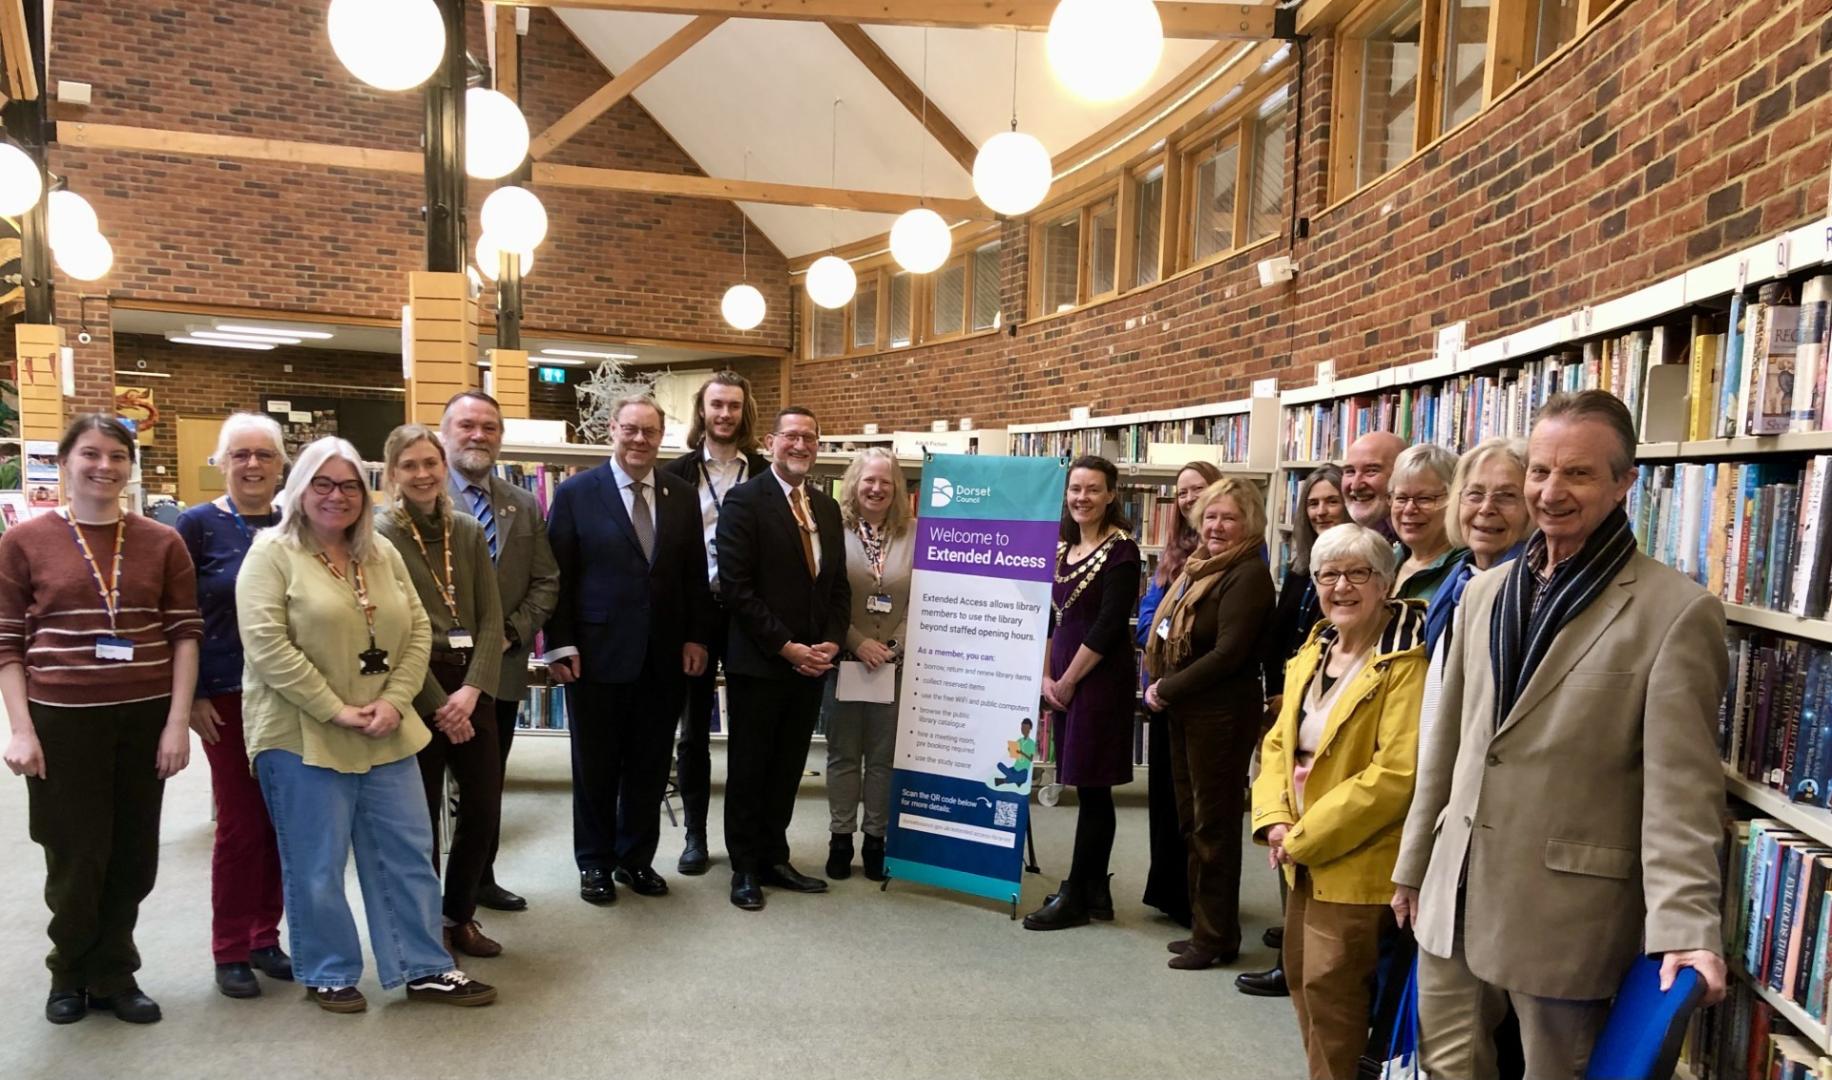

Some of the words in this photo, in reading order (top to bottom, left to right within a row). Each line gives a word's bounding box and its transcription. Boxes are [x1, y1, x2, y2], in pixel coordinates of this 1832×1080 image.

[1777, 242, 1785, 268] Q
[1778, 288, 1793, 304] A
[956, 485, 991, 496] Dorset
[930, 526, 992, 545] Welcome
[996, 532, 1009, 546] to
[927, 546, 991, 565] Extended
[994, 551, 1046, 568] Access
[923, 594, 958, 604] Extended
[960, 597, 988, 607] Access
[989, 600, 1014, 610] allows
[1016, 602, 1041, 614] library
[921, 608, 957, 619] members
[959, 612, 967, 620] to
[984, 614, 997, 623] the
[998, 616, 1022, 627] library
[920, 622, 948, 633] beyond
[949, 625, 976, 636] staffed
[978, 629, 1009, 640] opening
[1011, 630, 1035, 641] hours.
[917, 646, 926, 655] As
[934, 649, 964, 660] member,
[965, 653, 979, 661] you
[924, 663, 944, 671] borrow,
[995, 670, 1013, 680] library
[1014, 674, 1031, 682] items
[922, 678, 941, 686] collect
[943, 680, 967, 689] reserved
[969, 683, 985, 691] items
[933, 693, 942, 701] the
[943, 694, 954, 702] free
[980, 699, 997, 708] public
[998, 702, 1030, 712] computers
[920, 706, 941, 715] browse
[953, 711, 969, 719] public
[919, 716, 936, 726] library
[938, 719, 966, 729] catalogue
[917, 730, 928, 738] hire
[934, 733, 957, 743] meeting
[927, 742, 950, 751] booking
[951, 745, 975, 754] required
[938, 758, 953, 767] study
[954, 761, 972, 769] space
[901, 798, 910, 806] for
[911, 800, 928, 809] more
[929, 803, 951, 813] details:
[902, 788, 919, 799] Scan
[920, 791, 930, 800] the
[930, 793, 941, 802] QR
[941, 796, 957, 805] code
[957, 797, 977, 808] below
[1773, 958, 1784, 979] KEY
